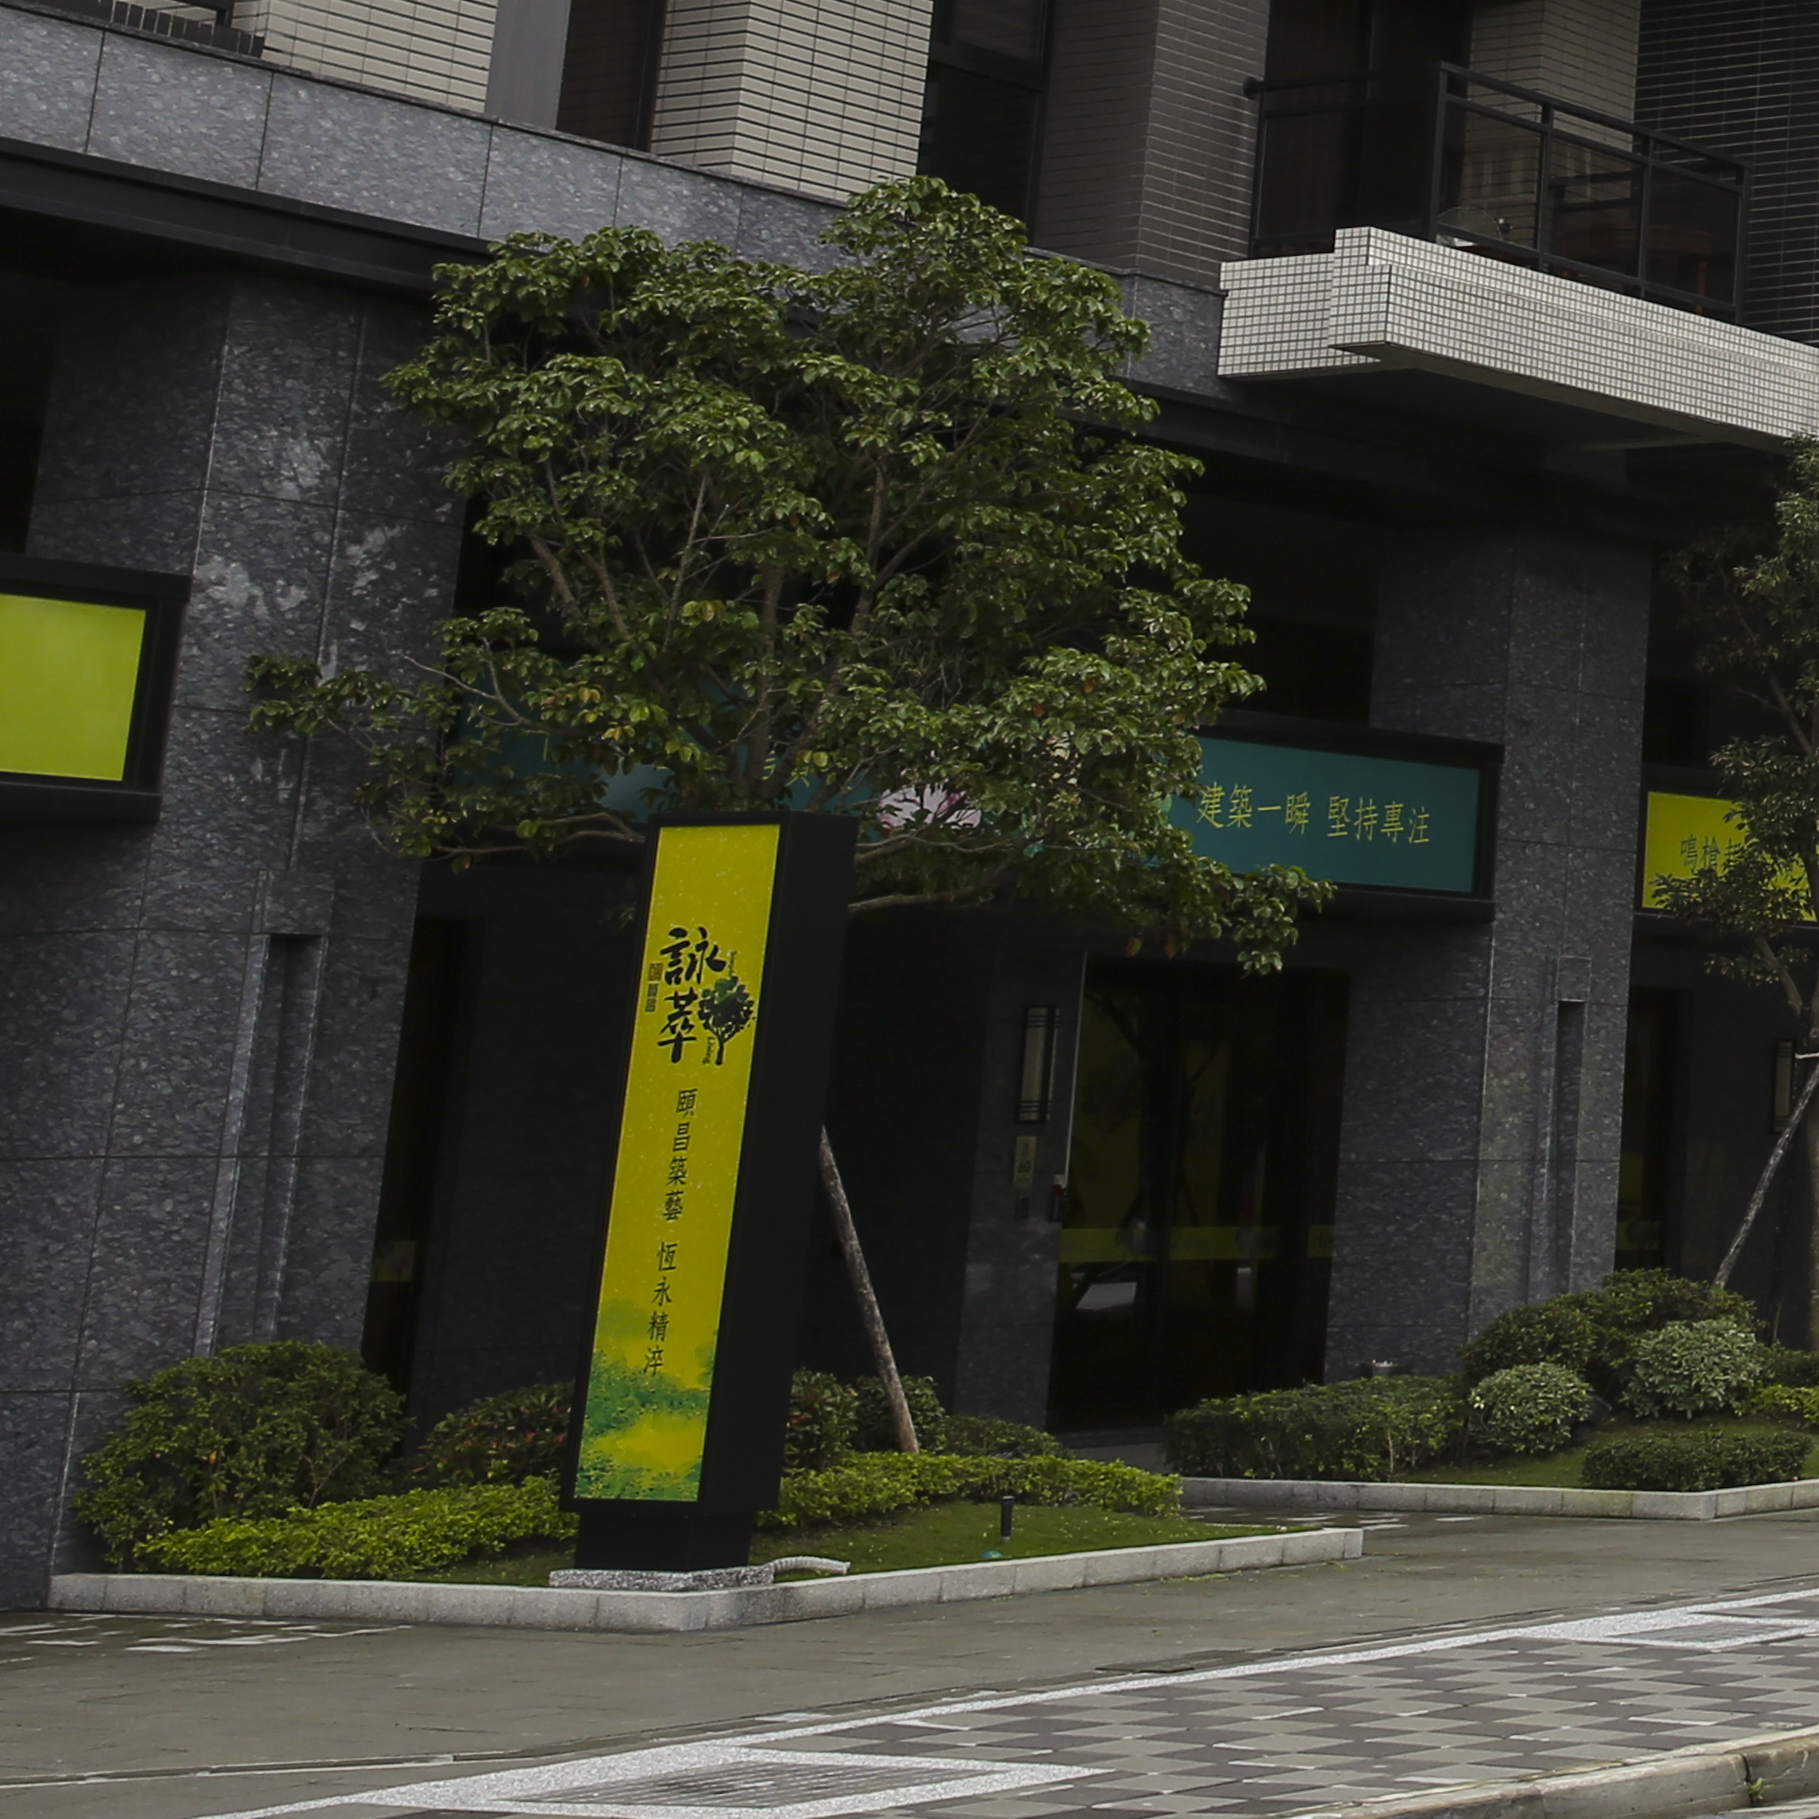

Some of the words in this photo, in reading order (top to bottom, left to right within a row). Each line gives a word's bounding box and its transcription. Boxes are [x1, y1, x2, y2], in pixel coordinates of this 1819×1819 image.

[1327, 795, 1430, 844] 堅持專注
[662, 1088, 698, 1222] 頤昌築藝
